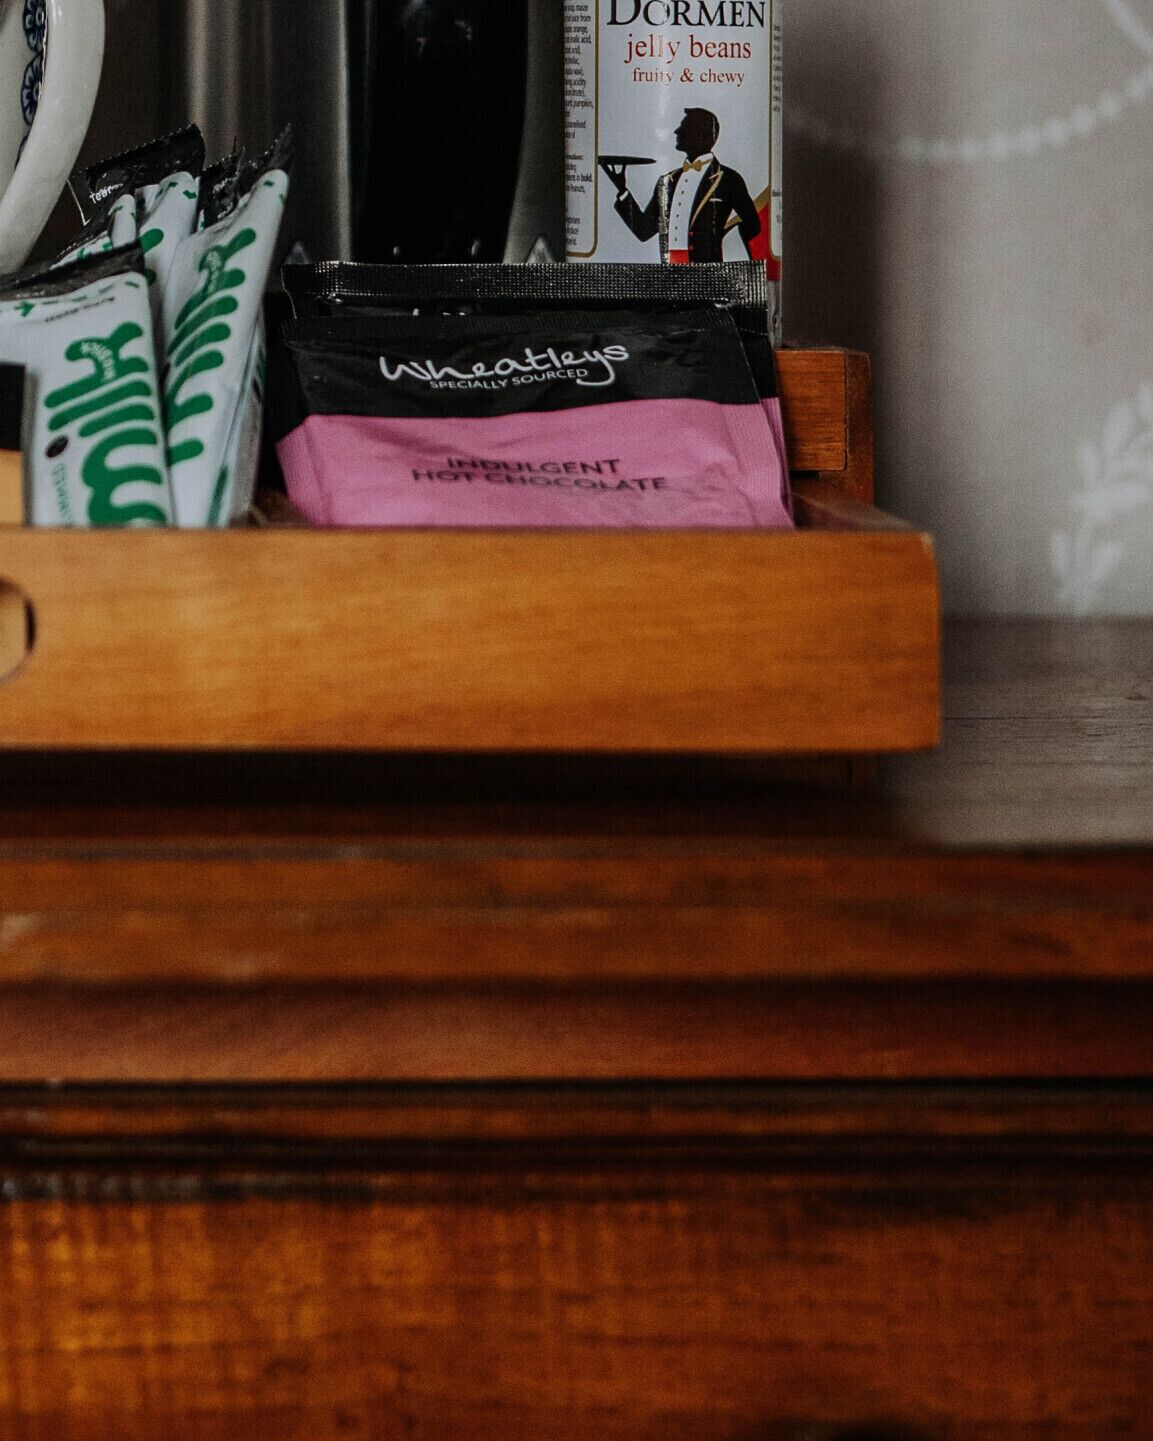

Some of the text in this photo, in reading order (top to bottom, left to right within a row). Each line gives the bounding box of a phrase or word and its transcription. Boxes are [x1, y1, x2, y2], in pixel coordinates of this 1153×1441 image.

[624, 33, 752, 64] jelly beans
[632, 67, 745, 87] fruity & chewy
[379, 345, 629, 387] Wheatleys
[429, 368, 589, 391] SPECIALLY SOURCED
[447, 458, 621, 475] INDULGENT
[411, 468, 668, 491] HOT CHOCOLATE
